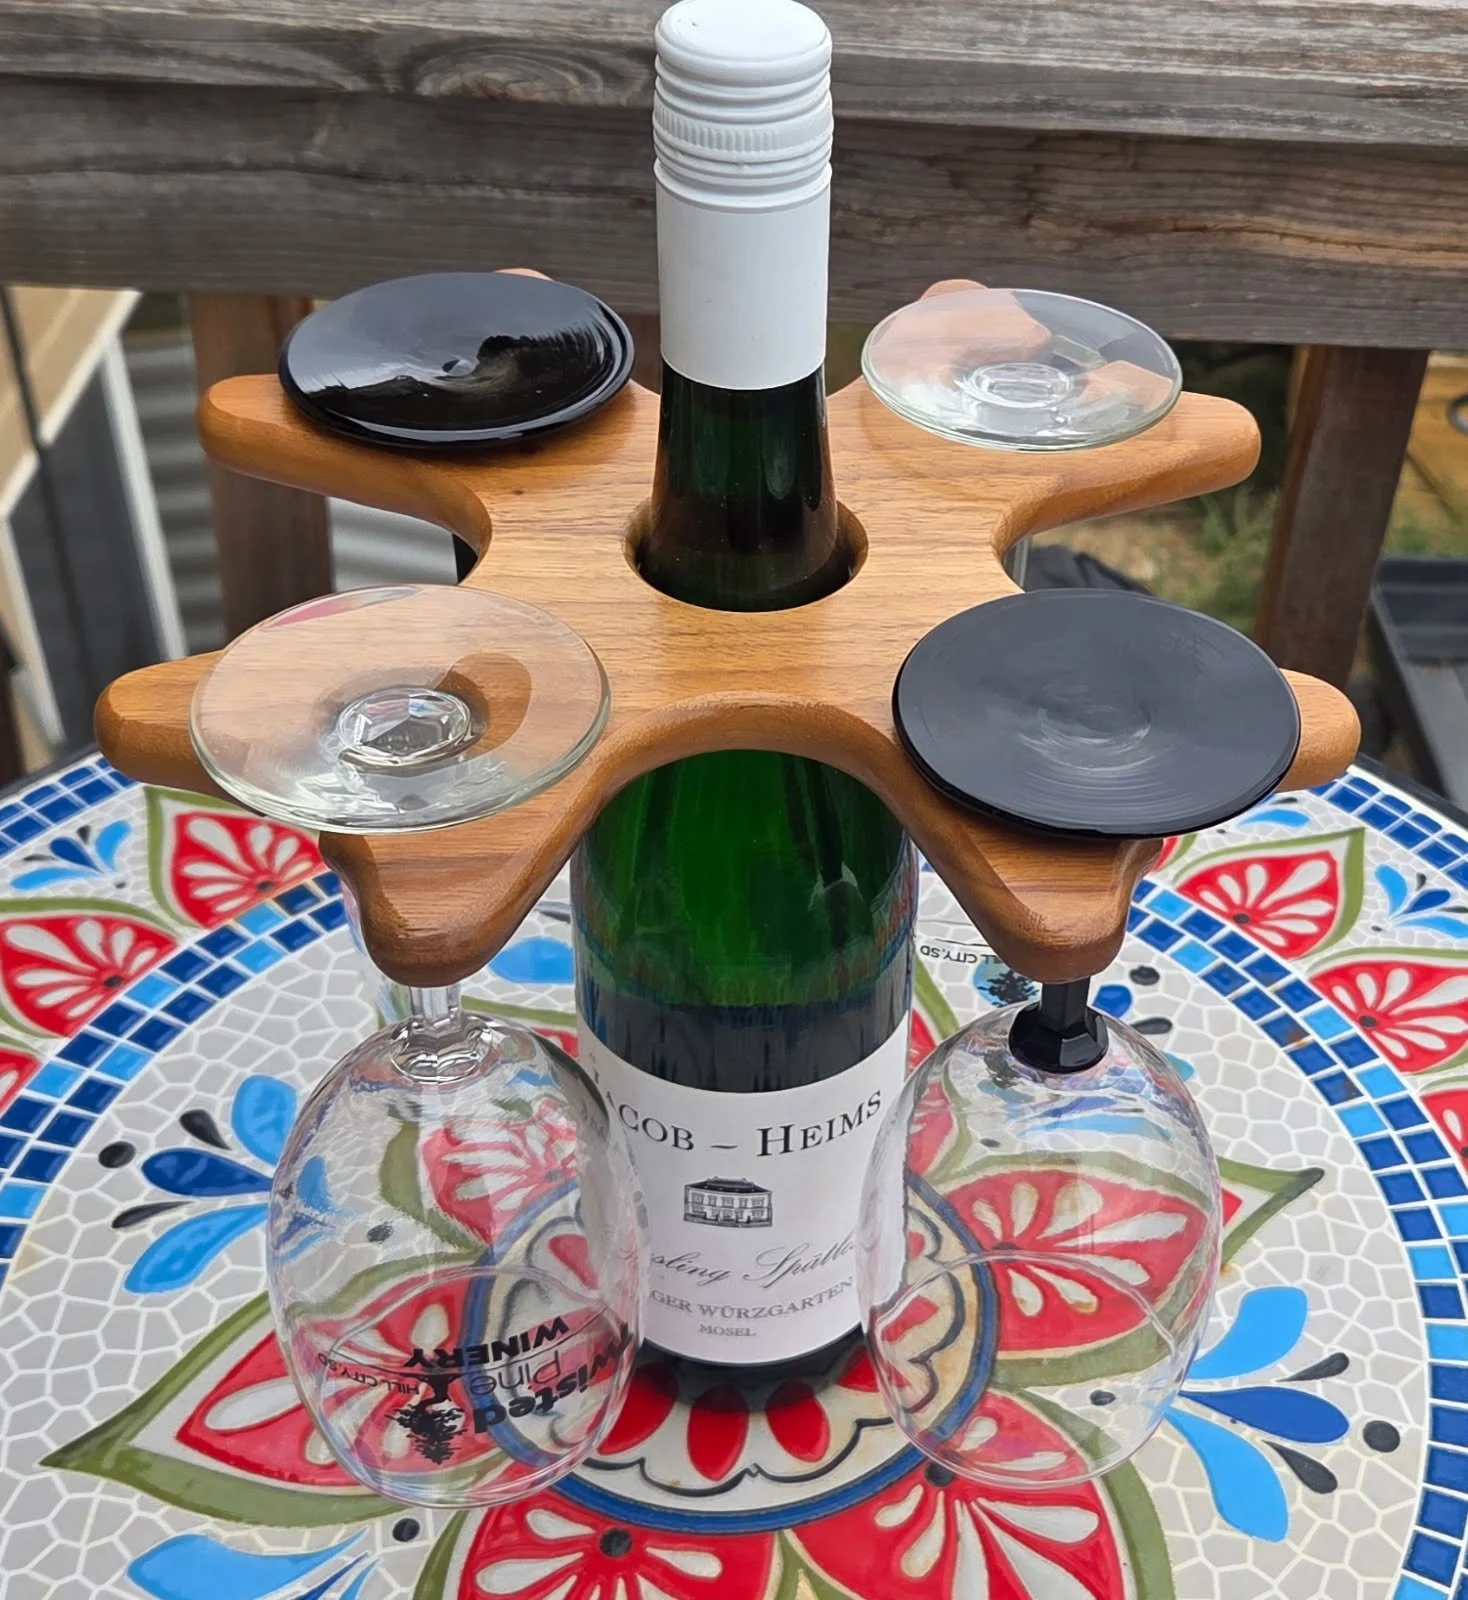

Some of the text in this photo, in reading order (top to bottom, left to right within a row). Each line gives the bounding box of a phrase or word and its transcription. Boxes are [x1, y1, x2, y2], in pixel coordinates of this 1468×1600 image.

[756, 1090, 882, 1157] HEIMS
[651, 1251, 732, 1287] sling
[651, 1290, 693, 1313] GER
[403, 1316, 570, 1368] WINERY
[698, 1323, 757, 1337] MOSEL
[380, 1379, 420, 1395] HILL
[470, 1350, 561, 1395] pine
